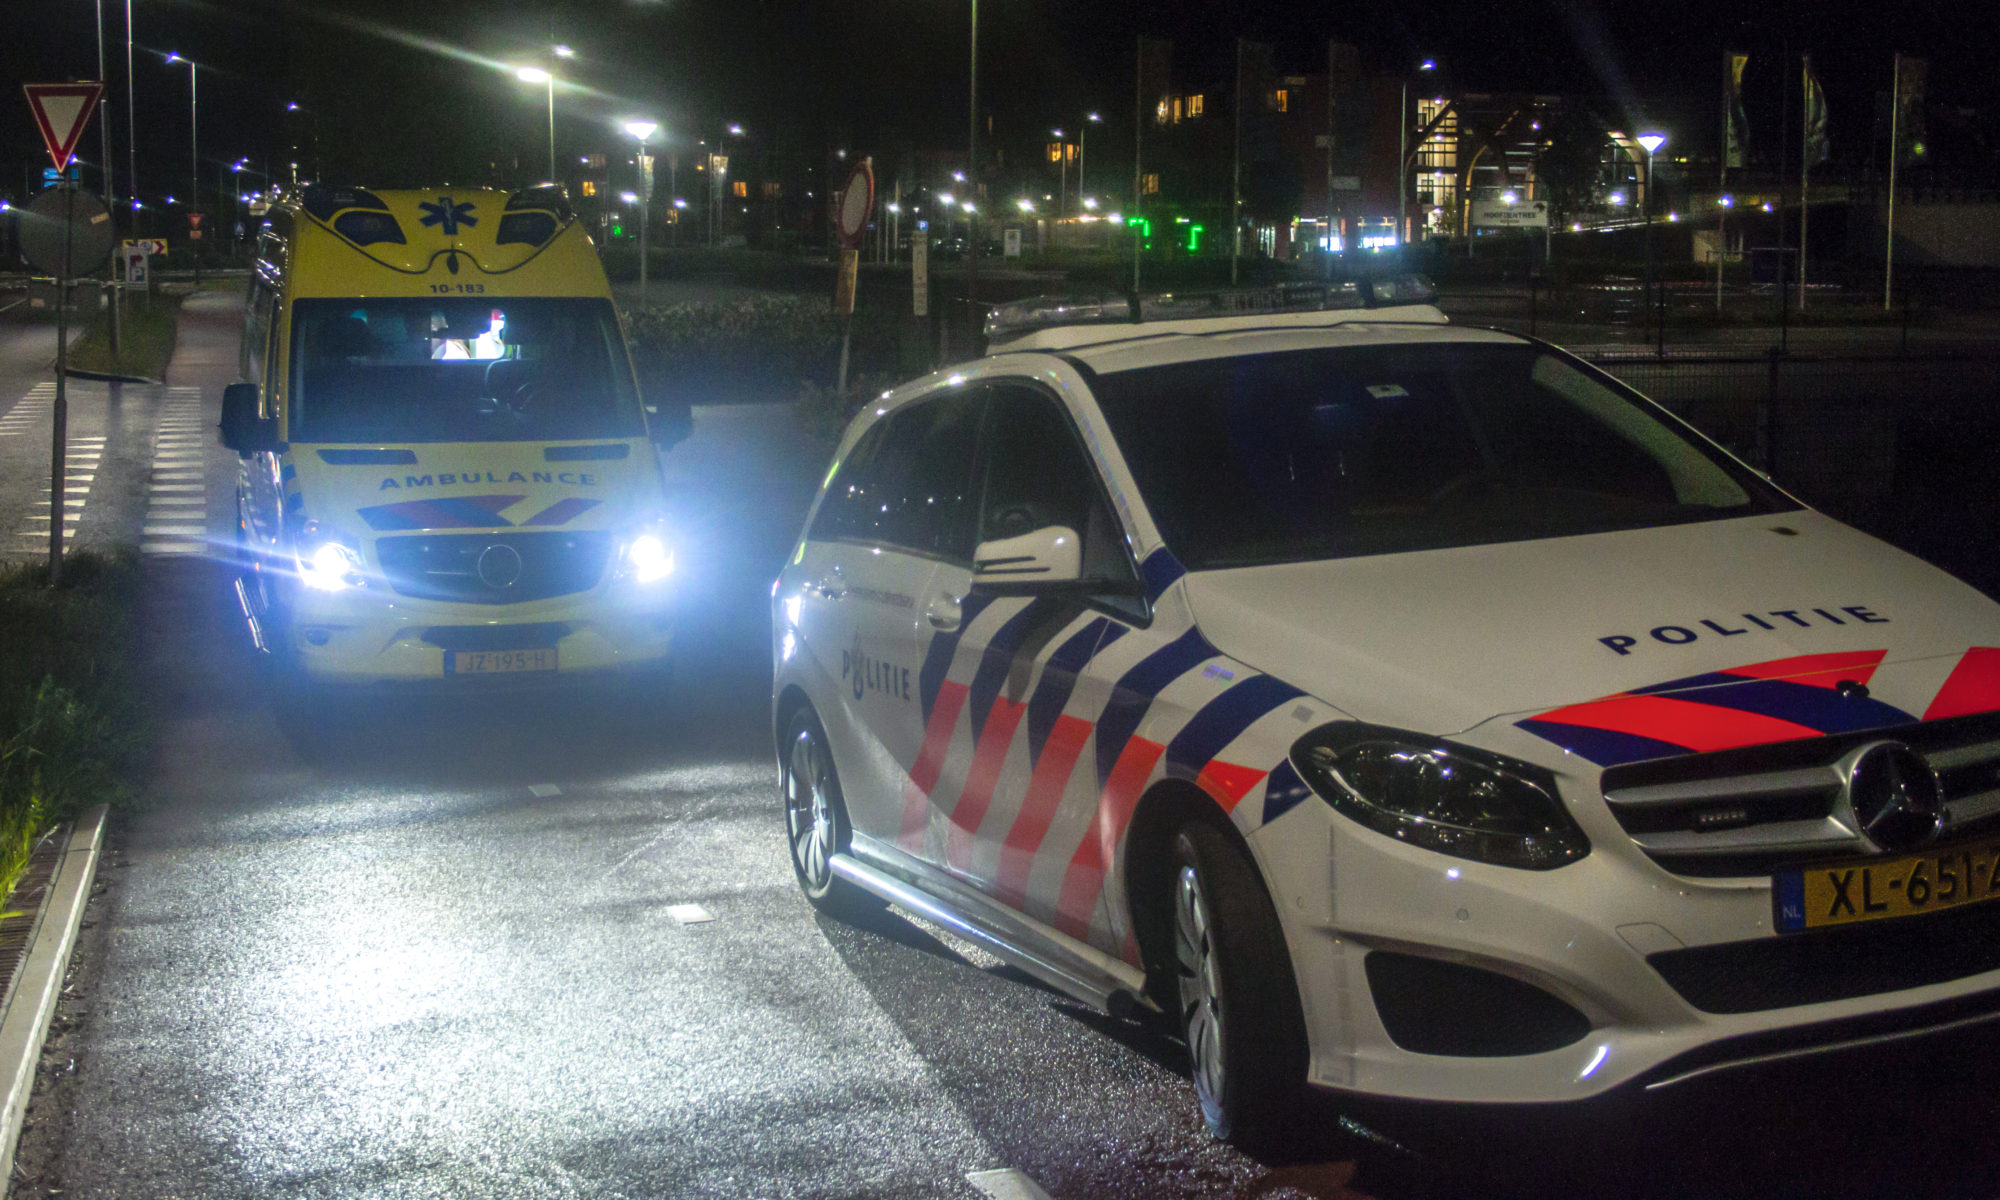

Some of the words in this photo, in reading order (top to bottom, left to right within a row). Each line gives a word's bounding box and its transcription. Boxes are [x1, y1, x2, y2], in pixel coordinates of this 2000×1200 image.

[131, 267, 143, 281] P
[430, 284, 485, 294] 10-183
[379, 472, 596, 490] AMBULANCE
[1596, 606, 1891, 656] POLITIE
[842, 649, 911, 701] POLITIE
[1782, 904, 1801, 919] NL
